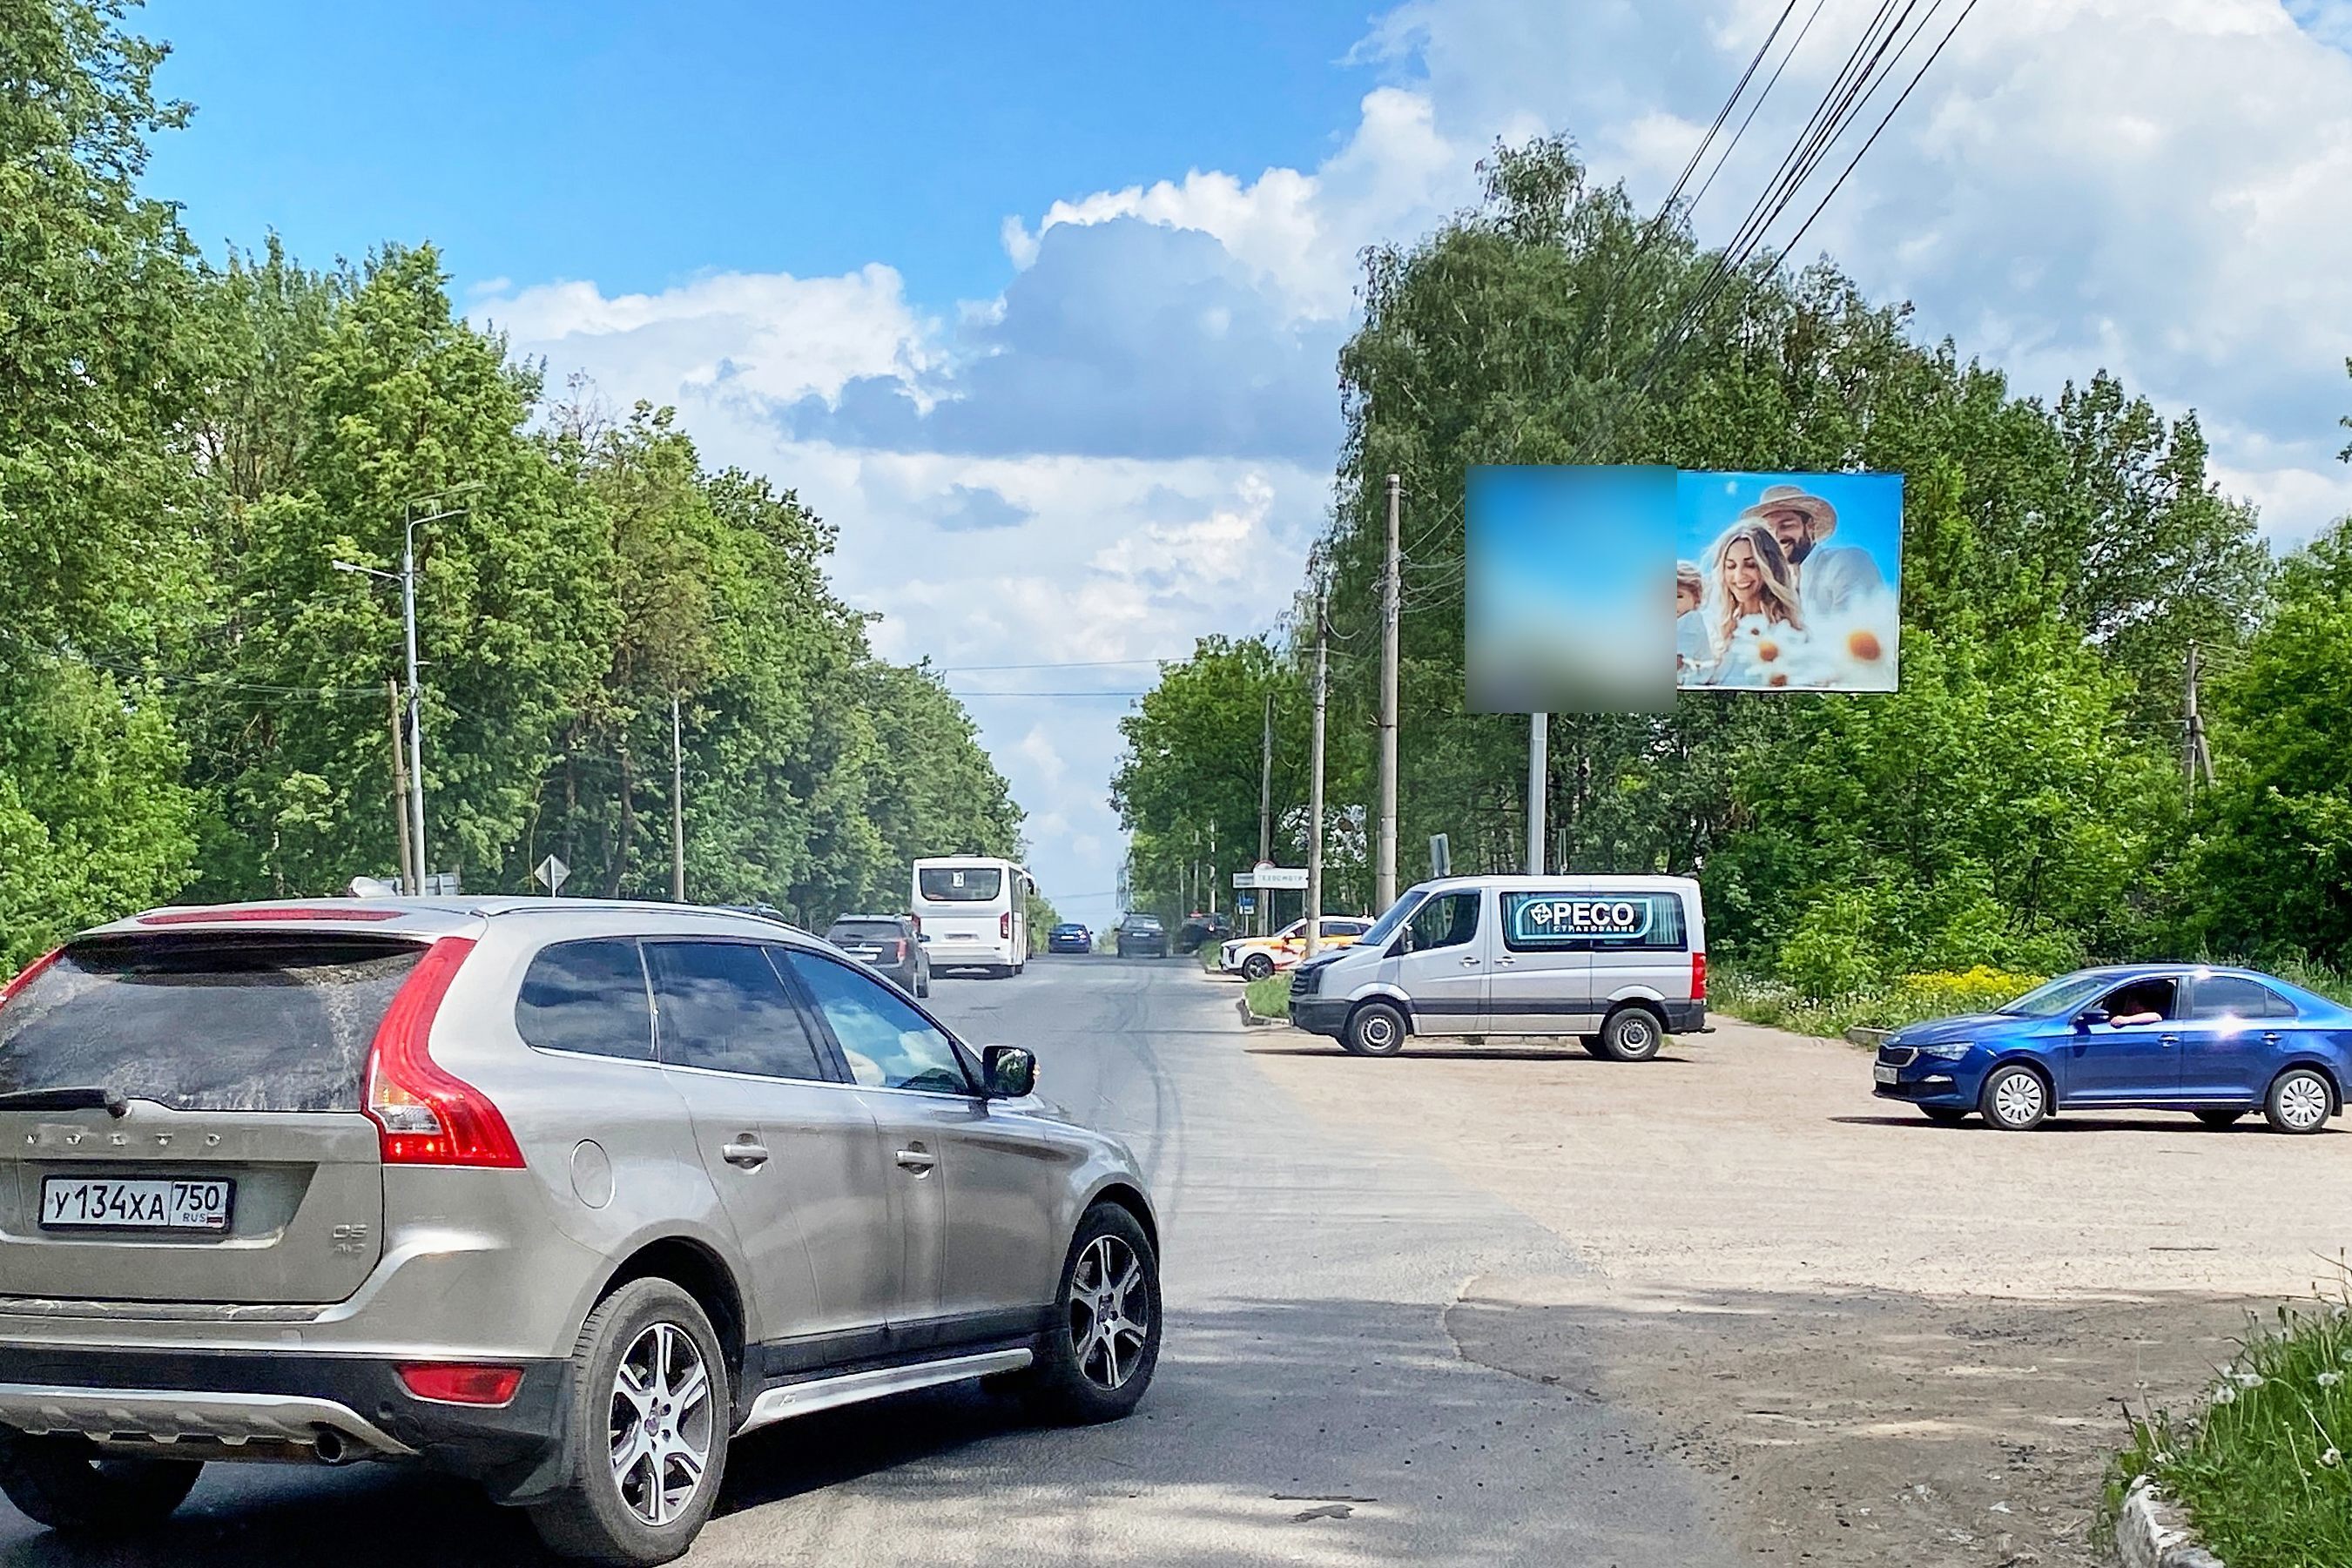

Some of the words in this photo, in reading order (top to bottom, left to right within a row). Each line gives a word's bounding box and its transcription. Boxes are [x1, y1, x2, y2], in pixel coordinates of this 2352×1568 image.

[1553, 902, 1634, 926] РЕСО
[174, 1184, 219, 1211] 750
[182, 1213, 206, 1223] RUS
